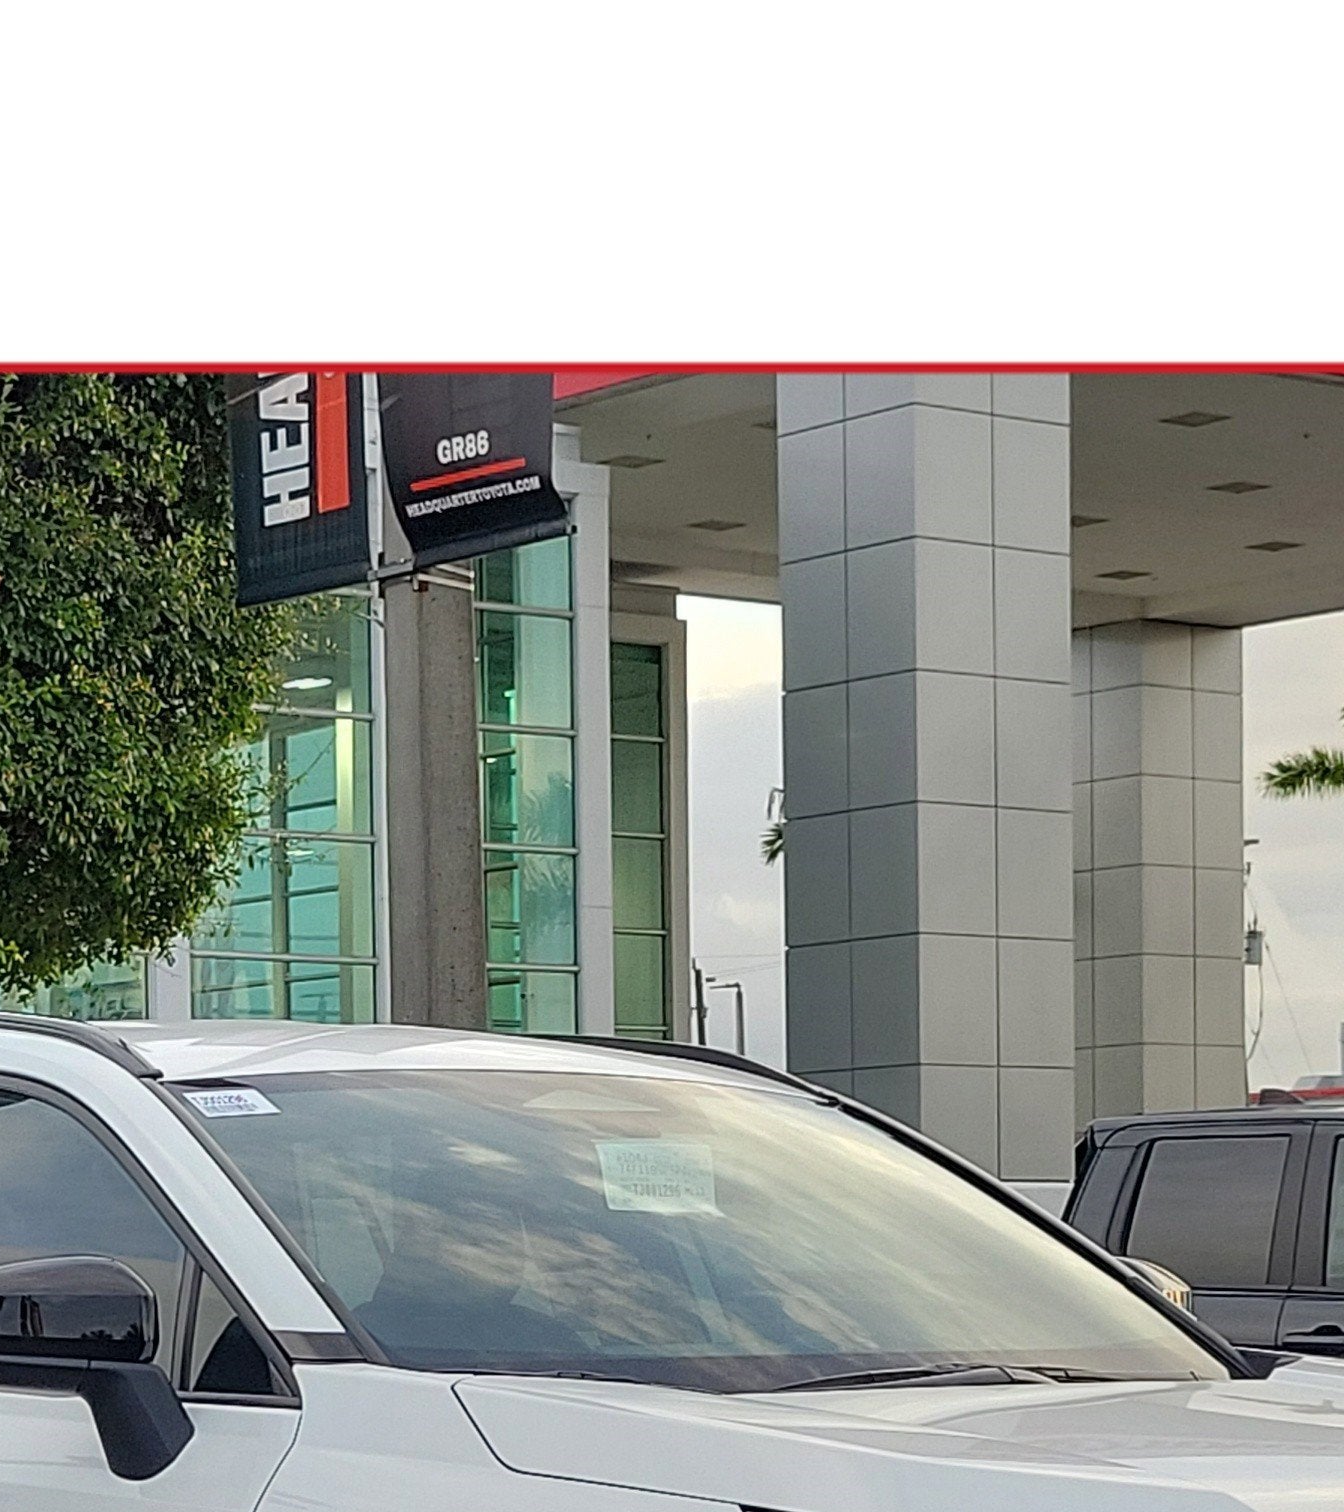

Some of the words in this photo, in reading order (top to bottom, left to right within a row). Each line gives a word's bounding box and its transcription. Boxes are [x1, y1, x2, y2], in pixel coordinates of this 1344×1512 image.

[258, 373, 311, 527] HEA
[436, 429, 490, 464] GR86
[405, 475, 542, 518] HEADQUARTERTOYOTA.COM
